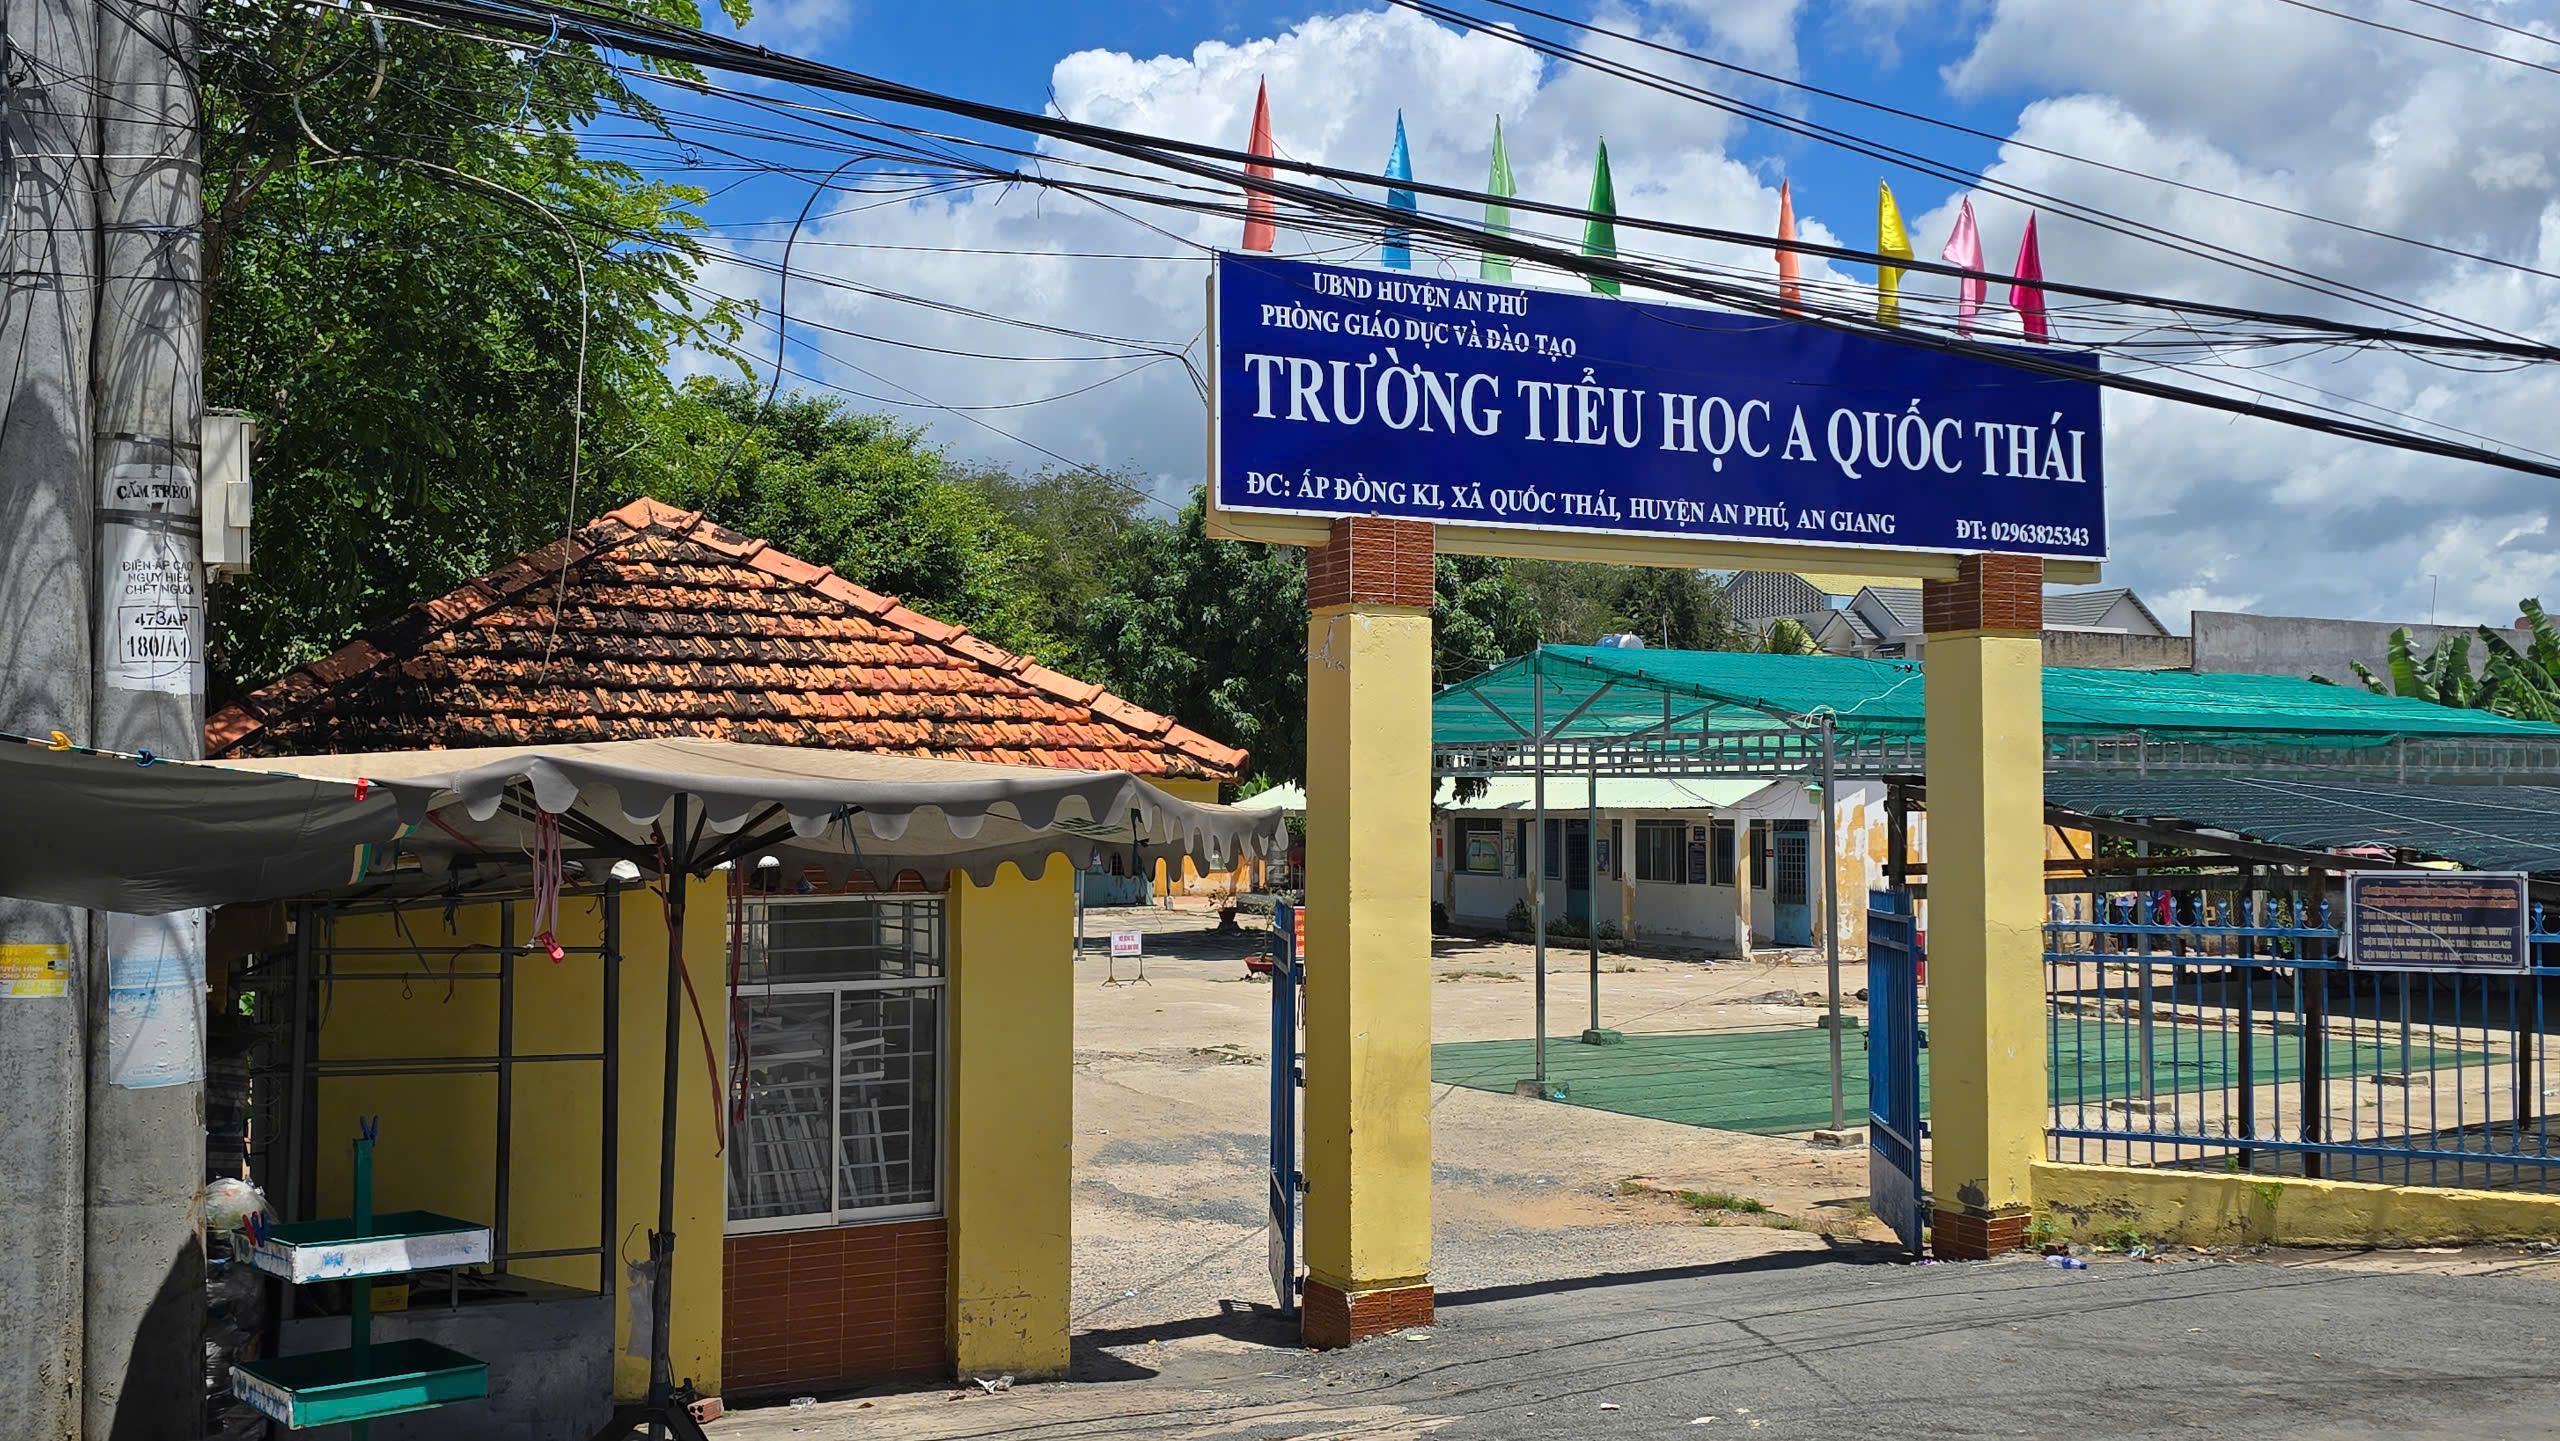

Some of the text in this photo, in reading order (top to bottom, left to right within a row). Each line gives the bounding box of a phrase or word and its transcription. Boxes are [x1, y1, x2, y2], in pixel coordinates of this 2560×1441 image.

[1313, 272, 1528, 317] UBND HUYỆN AN PHÚ
[1261, 301, 1577, 363] PHÒNG GIÁO DỤC VÀ ĐÀO TẠO
[1245, 347, 2087, 483] TRƯỜNG TIỂU HỌC A QUỐC THÁI
[1247, 468, 1897, 535] ĐC: ẤP ĐỒNG KI, XÃ QUỐC THÁI, HUYỆN AN PHÚ, AN GIANG
[1957, 519, 2090, 547] ĐT: 02963825343
[135, 611, 188, 627] 473AP
[127, 635, 187, 658] 180/A1
